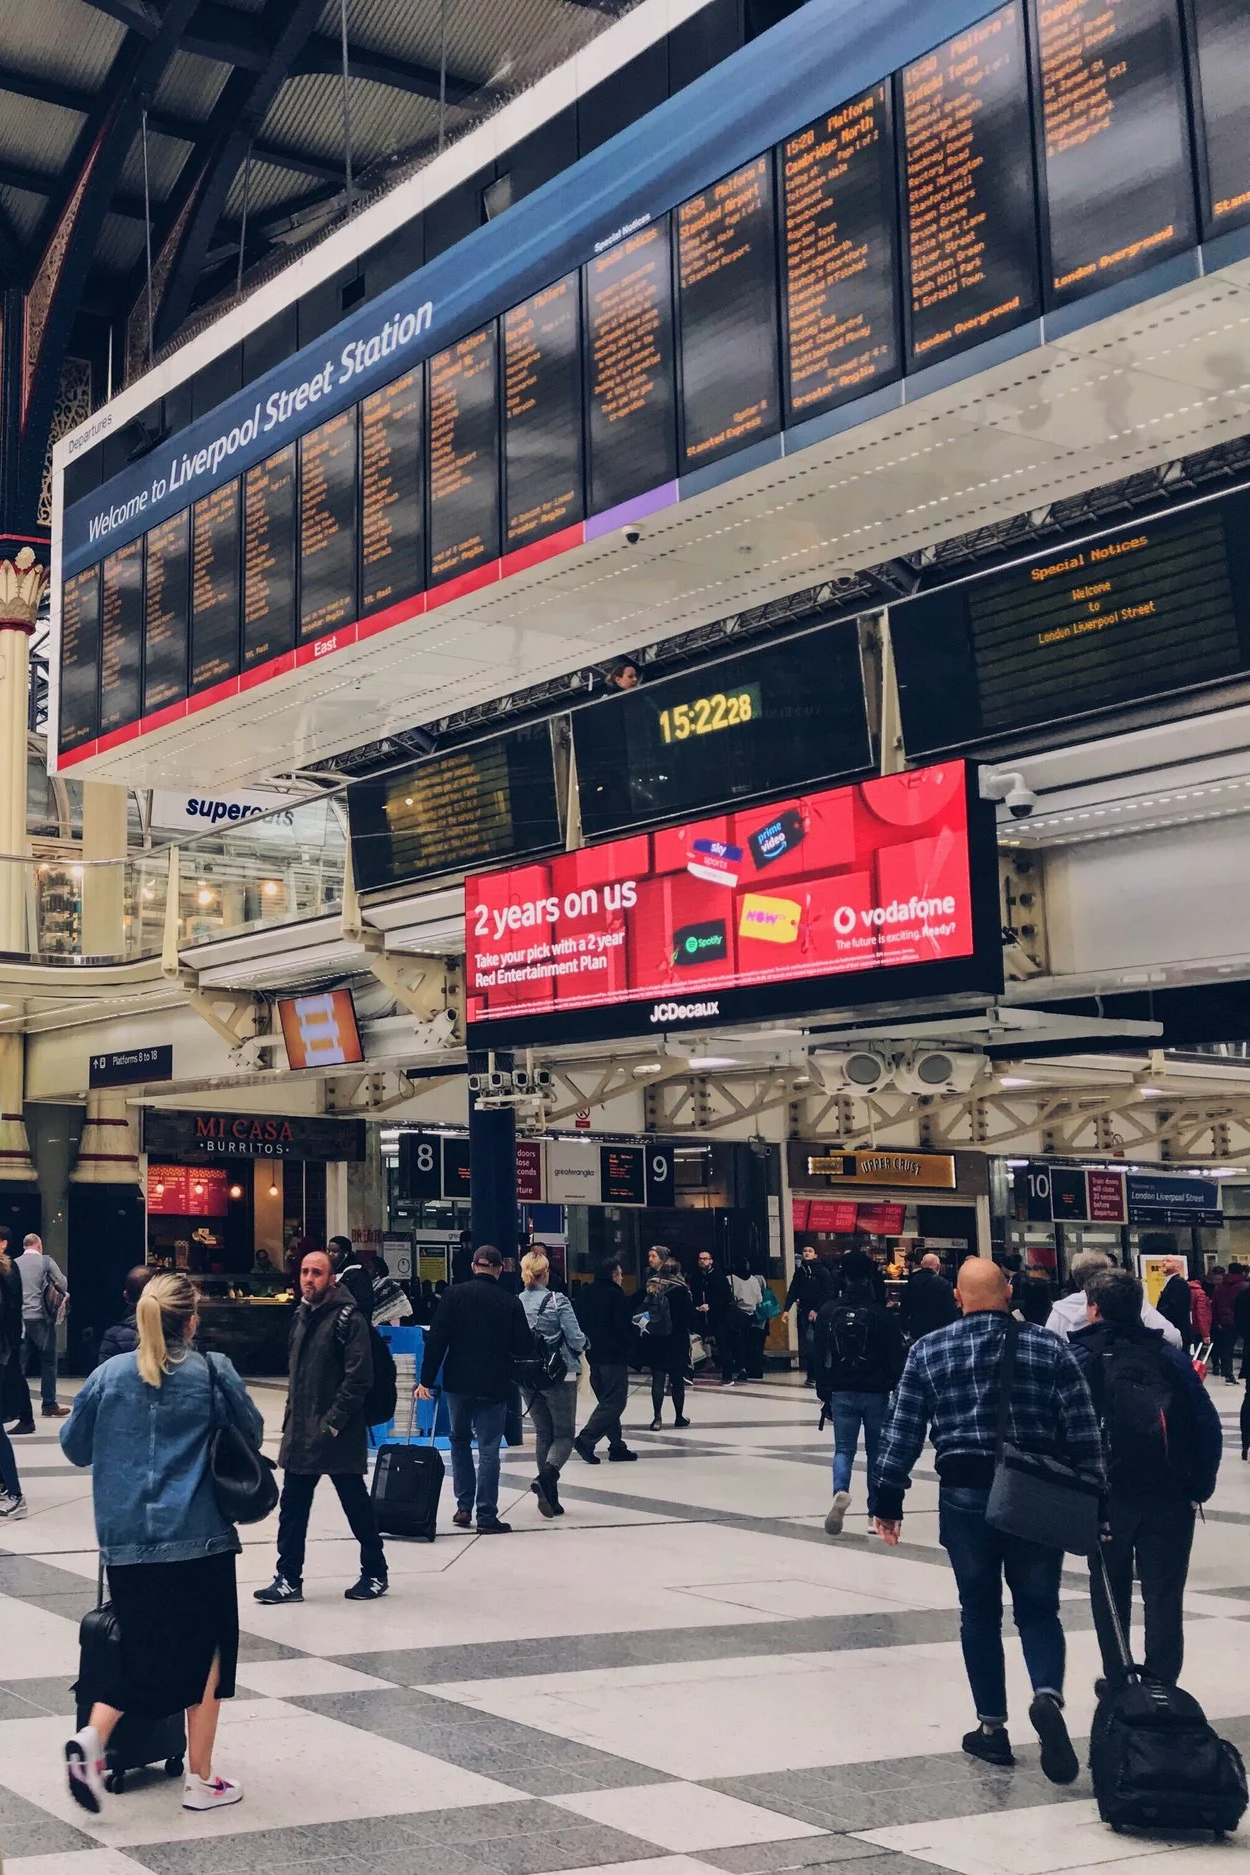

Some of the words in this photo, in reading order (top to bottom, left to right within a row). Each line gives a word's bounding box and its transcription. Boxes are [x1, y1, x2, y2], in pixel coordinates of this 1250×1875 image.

[786, 138, 837, 176] Cambridge
[841, 116, 874, 143] North
[594, 229, 622, 252] Special
[622, 213, 651, 235] Notices
[1054, 263, 1096, 289] London
[1099, 224, 1174, 270] Overground
[914, 331, 952, 353] London
[954, 296, 1020, 335] Overground
[793, 384, 834, 408] Greater
[839, 364, 875, 386] Anglia
[68, 413, 113, 454] Departures
[89, 490, 148, 543] Welcome
[151, 477, 166, 504] to
[169, 403, 260, 492] Liverpool
[263, 361, 334, 432] Street
[338, 301, 433, 384] Station
[686, 432, 724, 457] Stansted
[726, 416, 762, 438] Express
[1031, 553, 1084, 581] Special
[1090, 535, 1149, 561] Notices
[1072, 580, 1112, 601] Welcome
[1088, 601, 1100, 612] to
[1038, 626, 1071, 645] London
[1073, 611, 1119, 635] Liverpool
[1121, 600, 1157, 621] Street
[314, 635, 337, 656] East
[757, 821, 782, 845] prime
[760, 832, 786, 852] video
[711, 841, 727, 856] sky
[703, 855, 728, 869] sports
[474, 904, 489, 936] 2
[493, 896, 560, 940] years
[564, 888, 598, 918] on
[603, 880, 638, 911] us
[746, 910, 779, 924] NOW
[861, 895, 956, 927] vodafone
[698, 934, 723, 948] Spotify
[836, 939, 851, 950] The
[852, 936, 877, 948] future
[878, 934, 886, 944] is
[886, 929, 921, 943] exciting.
[922, 922, 956, 937] Ready?
[475, 952, 499, 968] Take
[500, 949, 525, 968] your
[527, 942, 550, 963] pick
[551, 939, 577, 957] with
[578, 941, 586, 951] a
[588, 934, 596, 950] 2
[597, 930, 626, 952] year
[475, 971, 495, 988] Red
[497, 959, 578, 984] Entertainment
[580, 954, 607, 971] Plan
[650, 1001, 720, 1023] JCDecaux
[113, 1055, 138, 1066] Platforms
[139, 1052, 143, 1062] 8
[144, 1053, 150, 1061] to
[151, 1050, 158, 1060] 18
[196, 1116, 226, 1138] MI
[232, 1118, 295, 1141] CASA
[207, 1140, 283, 1154] BURRITOS
[417, 1143, 433, 1172] 8
[517, 1149, 536, 1158] doors
[516, 1158, 530, 1167] lose
[517, 1167, 537, 1176] conds
[554, 1168, 594, 1177] greateranglia
[652, 1155, 668, 1182] 9
[861, 1157, 891, 1174] UPPER
[893, 1157, 922, 1176] CRUST
[1027, 1174, 1049, 1198] 10
[1131, 1191, 1155, 1200] London
[1156, 1192, 1185, 1203] Liverpool
[1185, 1193, 1205, 1203] Street
